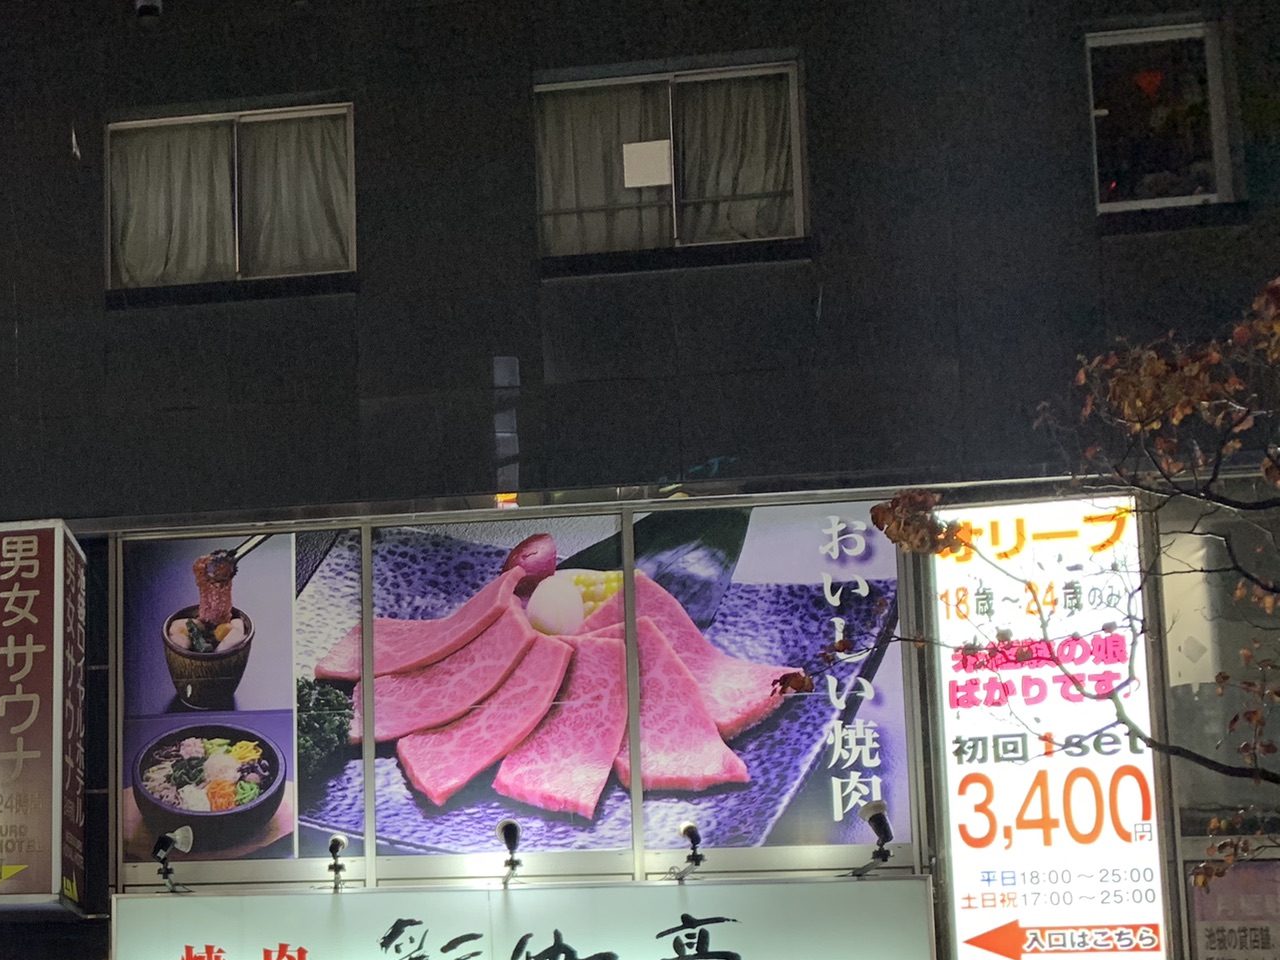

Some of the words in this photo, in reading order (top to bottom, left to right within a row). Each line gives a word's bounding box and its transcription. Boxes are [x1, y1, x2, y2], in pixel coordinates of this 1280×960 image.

[818, 513, 882, 822] おいしい焼肉
[1025, 929, 1157, 950] 入口はこちら
